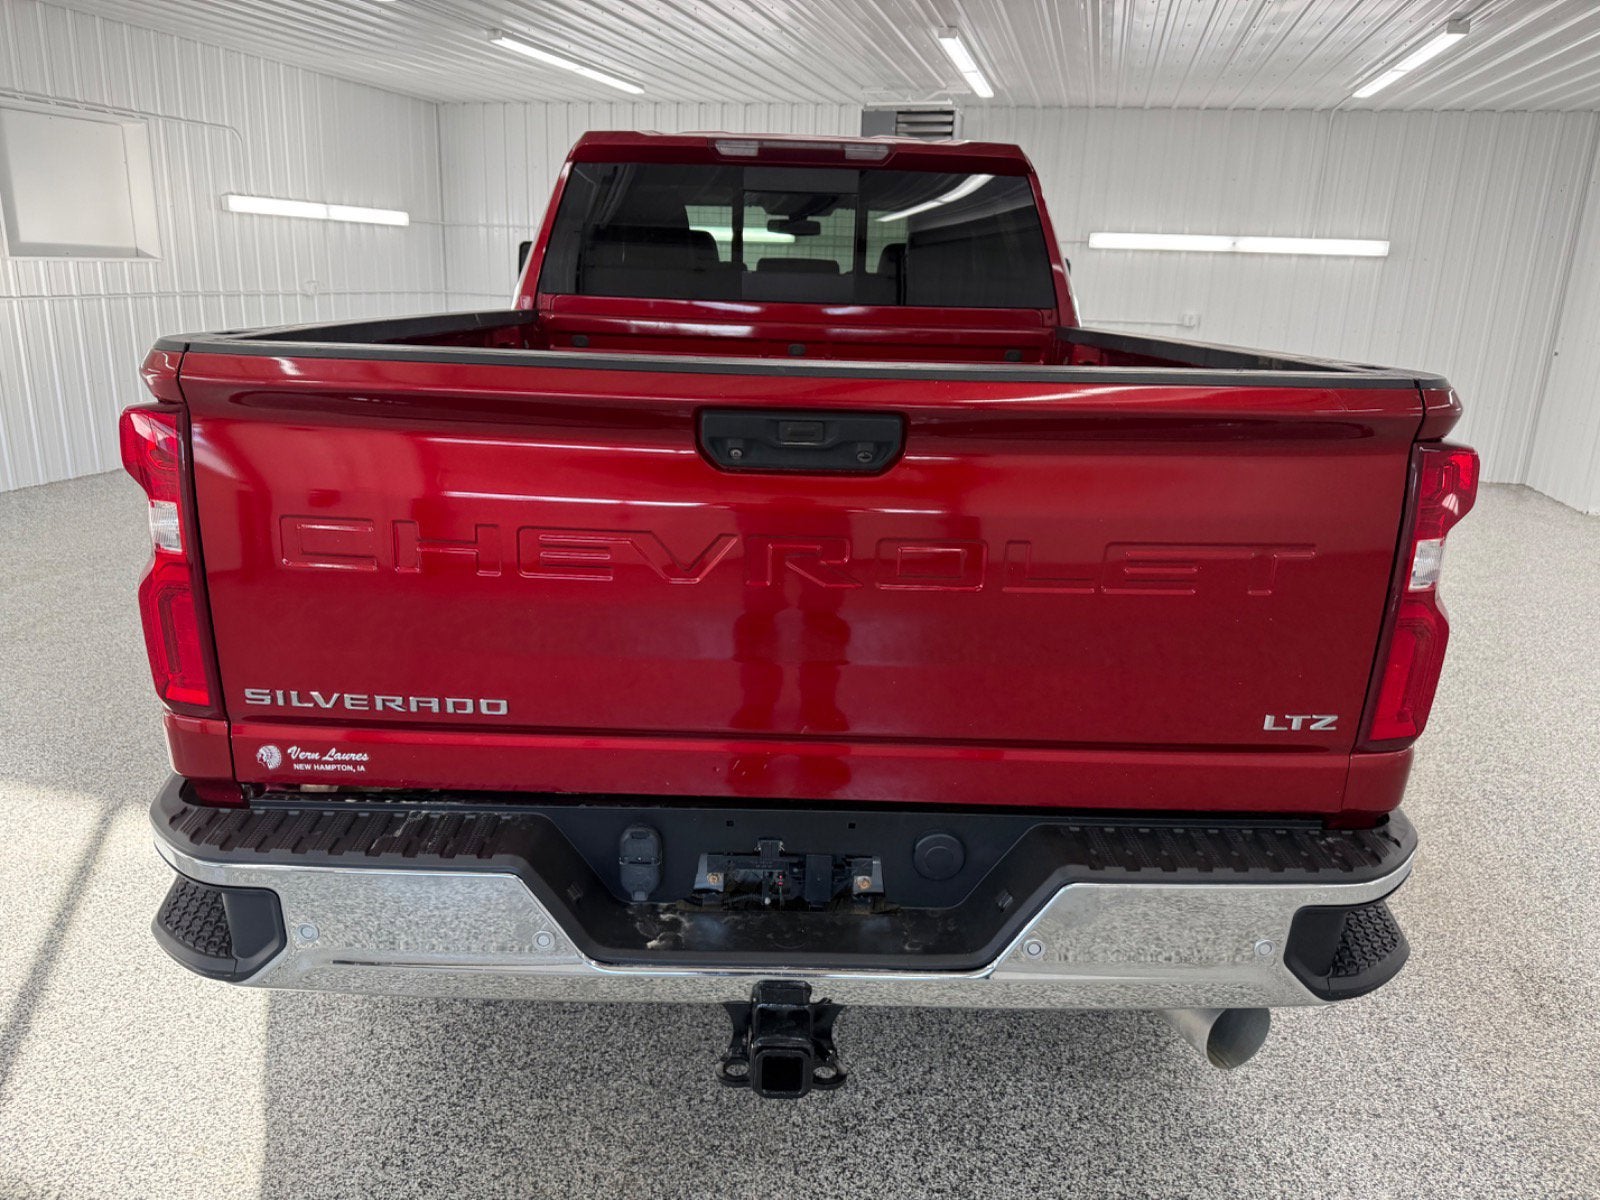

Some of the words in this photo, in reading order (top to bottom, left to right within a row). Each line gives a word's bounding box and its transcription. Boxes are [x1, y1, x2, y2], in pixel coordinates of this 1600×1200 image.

[279, 514, 1317, 596] CHEVROLET
[244, 688, 509, 716] SILVERADO
[1263, 714, 1338, 731] LTZ
[287, 745, 321, 760] Vern
[321, 747, 369, 762] Laures
[293, 763, 312, 771] NEW
[314, 763, 356, 773] HAMPTON,
[357, 764, 366, 772] IA
